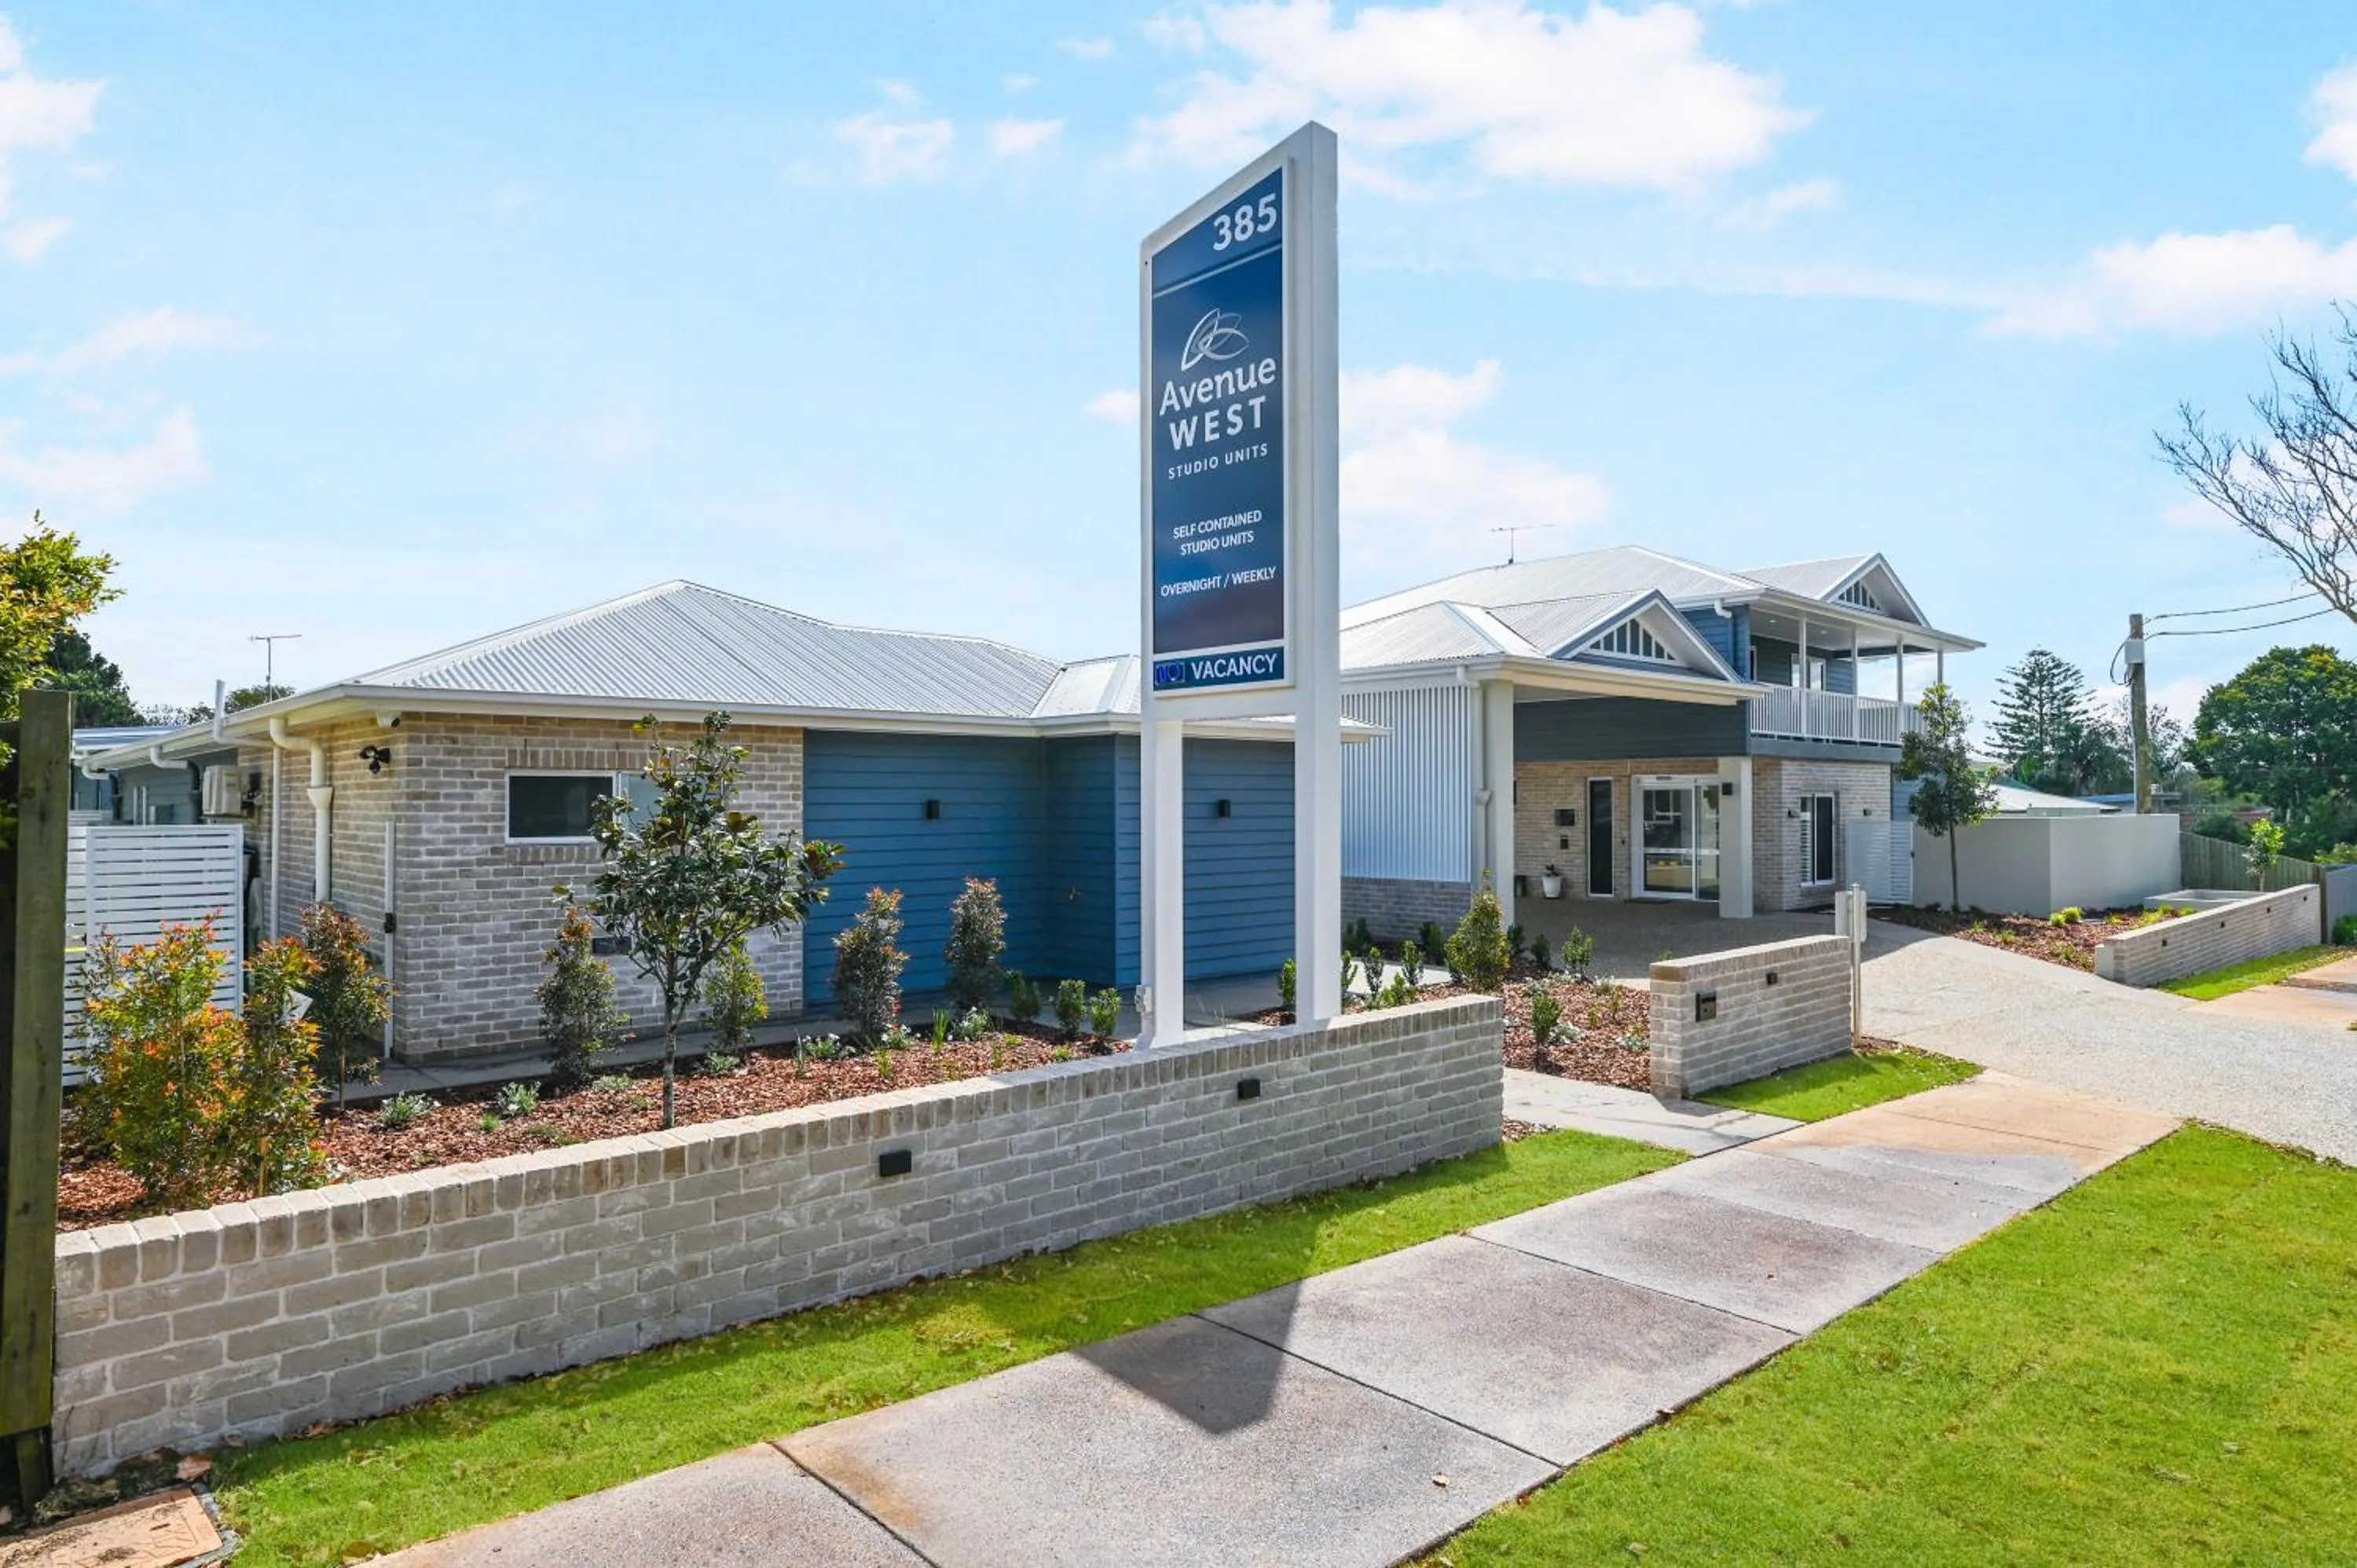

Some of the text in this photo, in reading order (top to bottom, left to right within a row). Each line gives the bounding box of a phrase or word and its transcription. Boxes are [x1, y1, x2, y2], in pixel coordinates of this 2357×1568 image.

[1212, 192, 1277, 251] 385
[1159, 357, 1277, 416] Avenue
[1169, 395, 1266, 451] WEST
[1168, 443, 1268, 480] STUDIO UNITS
[1173, 510, 1263, 540] SELF CONTAINED
[1181, 530, 1255, 556] STUDIO UNITS
[1160, 576, 1222, 597] OVERNIGHT
[1231, 566, 1277, 585] WEEKLY
[1191, 653, 1277, 680] VACANCY
